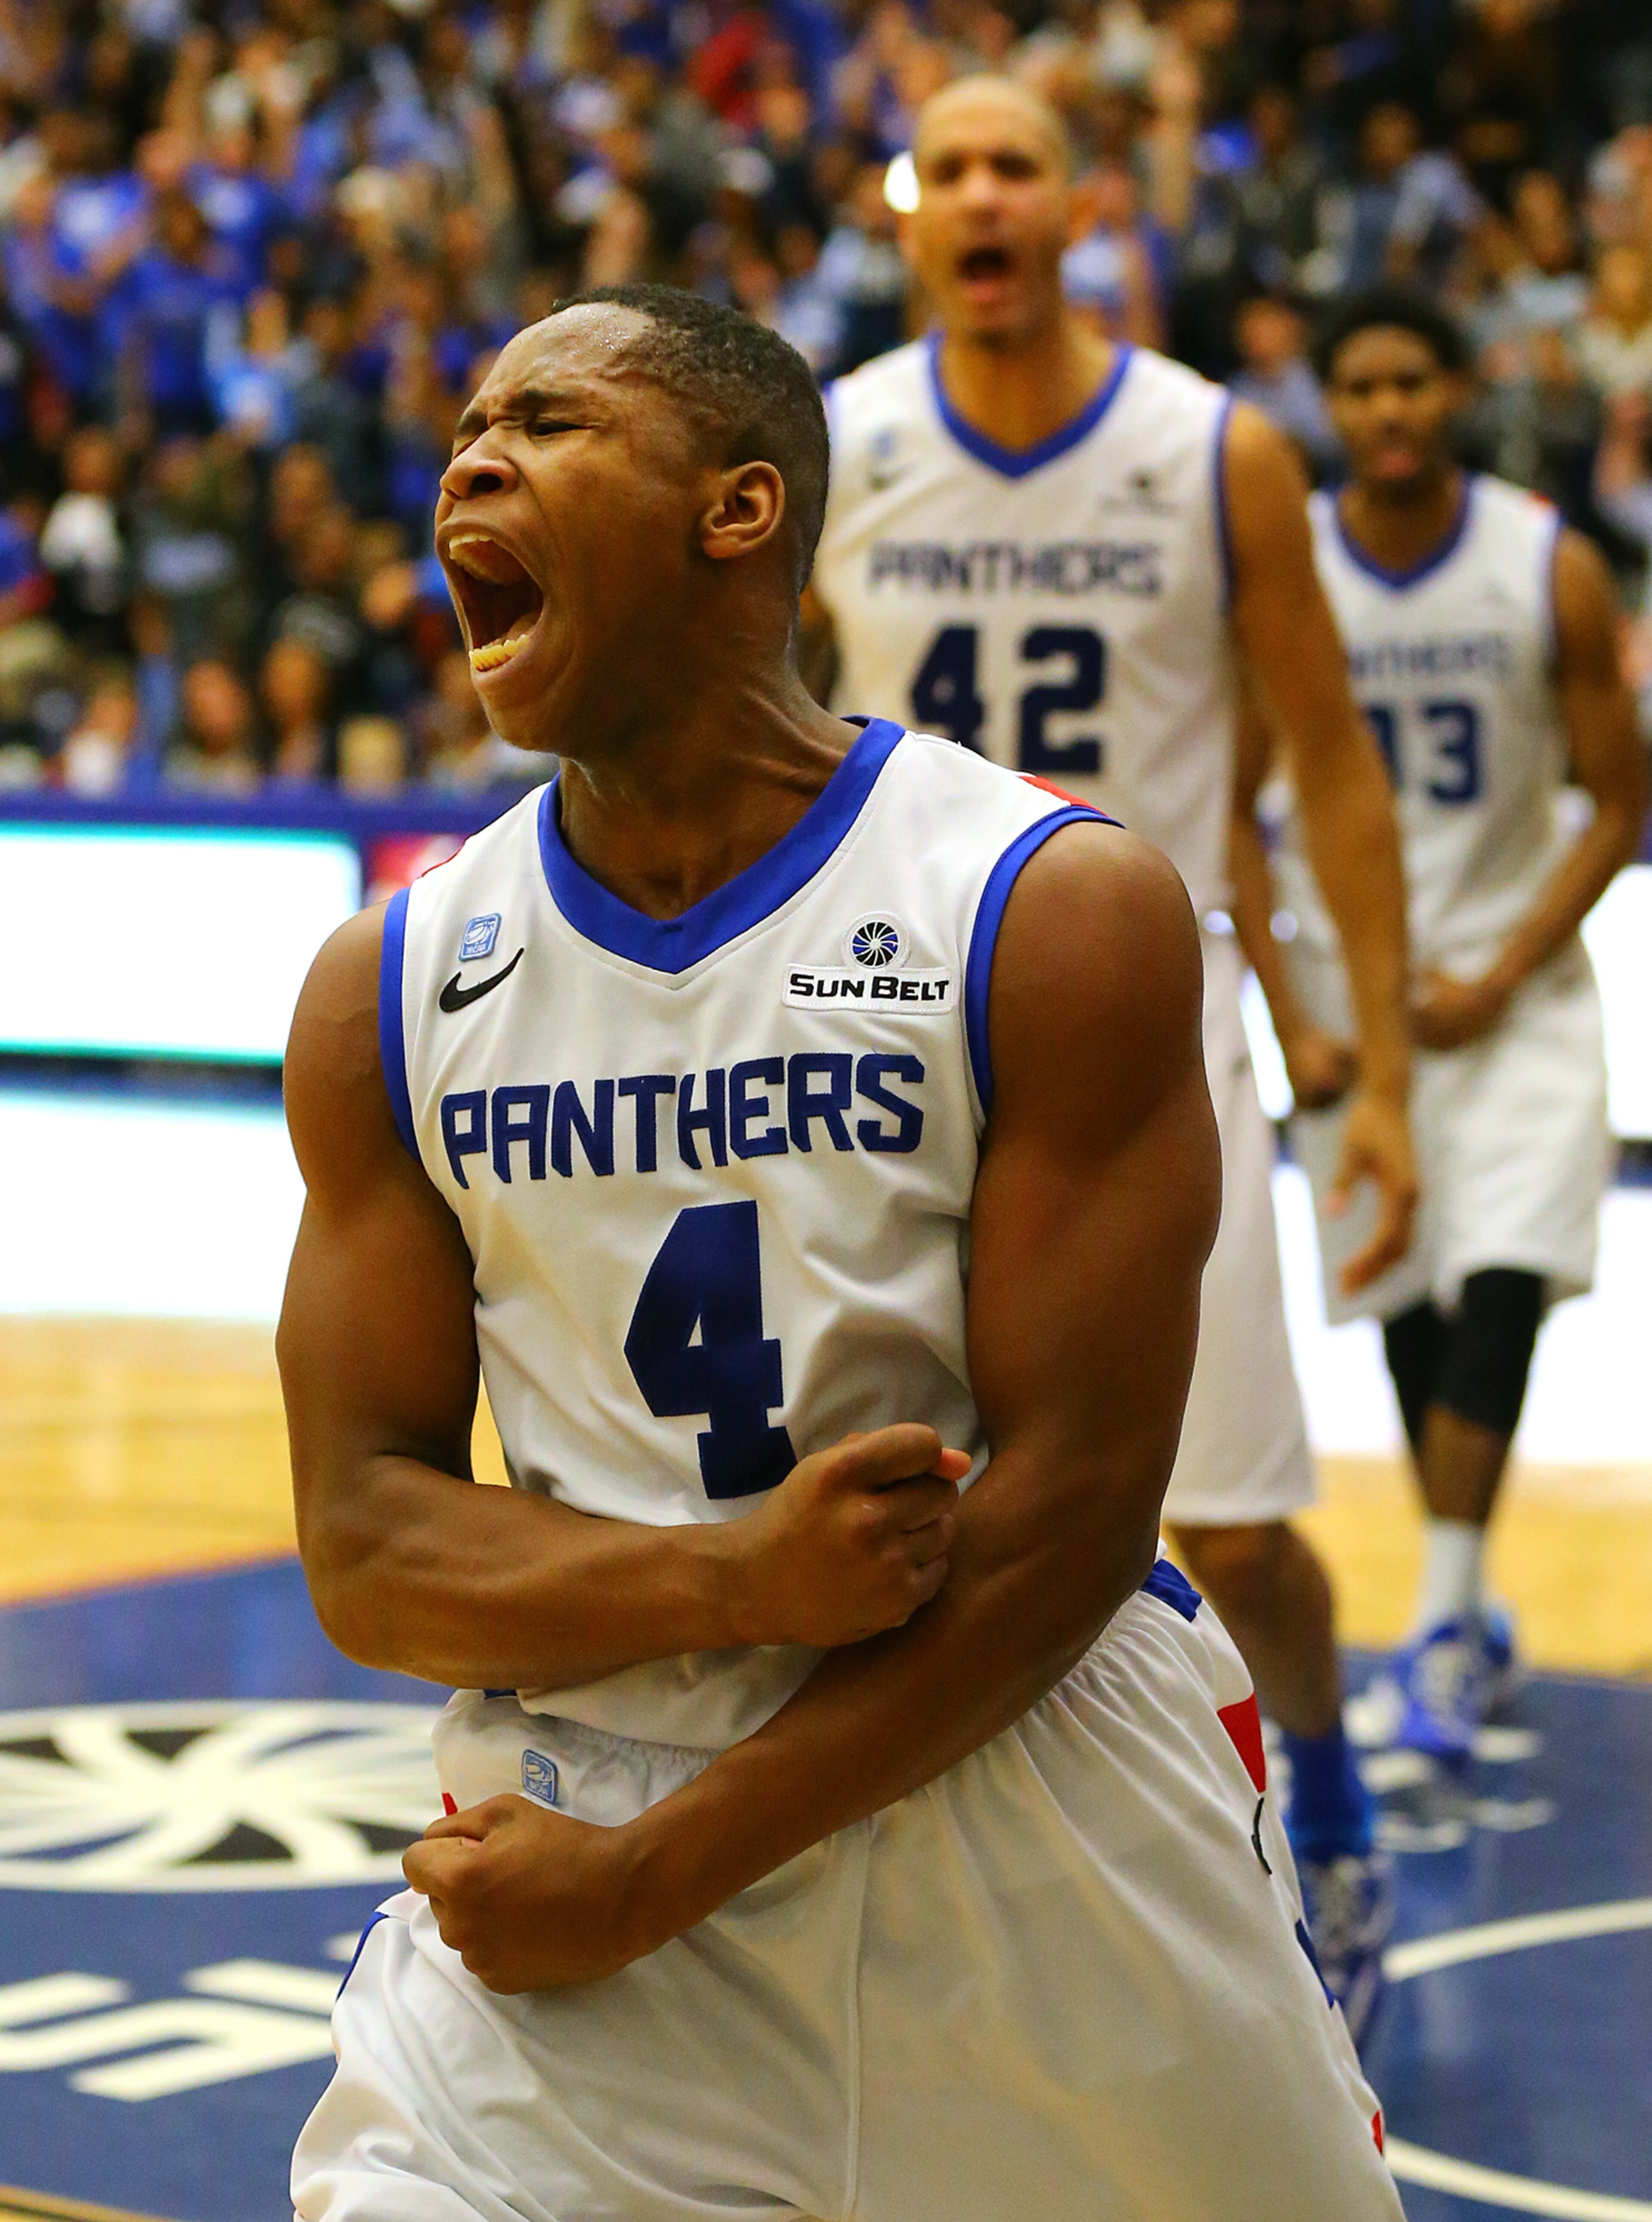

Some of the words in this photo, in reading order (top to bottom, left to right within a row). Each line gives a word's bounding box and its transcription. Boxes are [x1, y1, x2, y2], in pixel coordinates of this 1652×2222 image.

[910, 624, 1106, 774] 42
[441, 1052, 924, 1189] PANTHERS
[624, 1199, 798, 1500] 4
